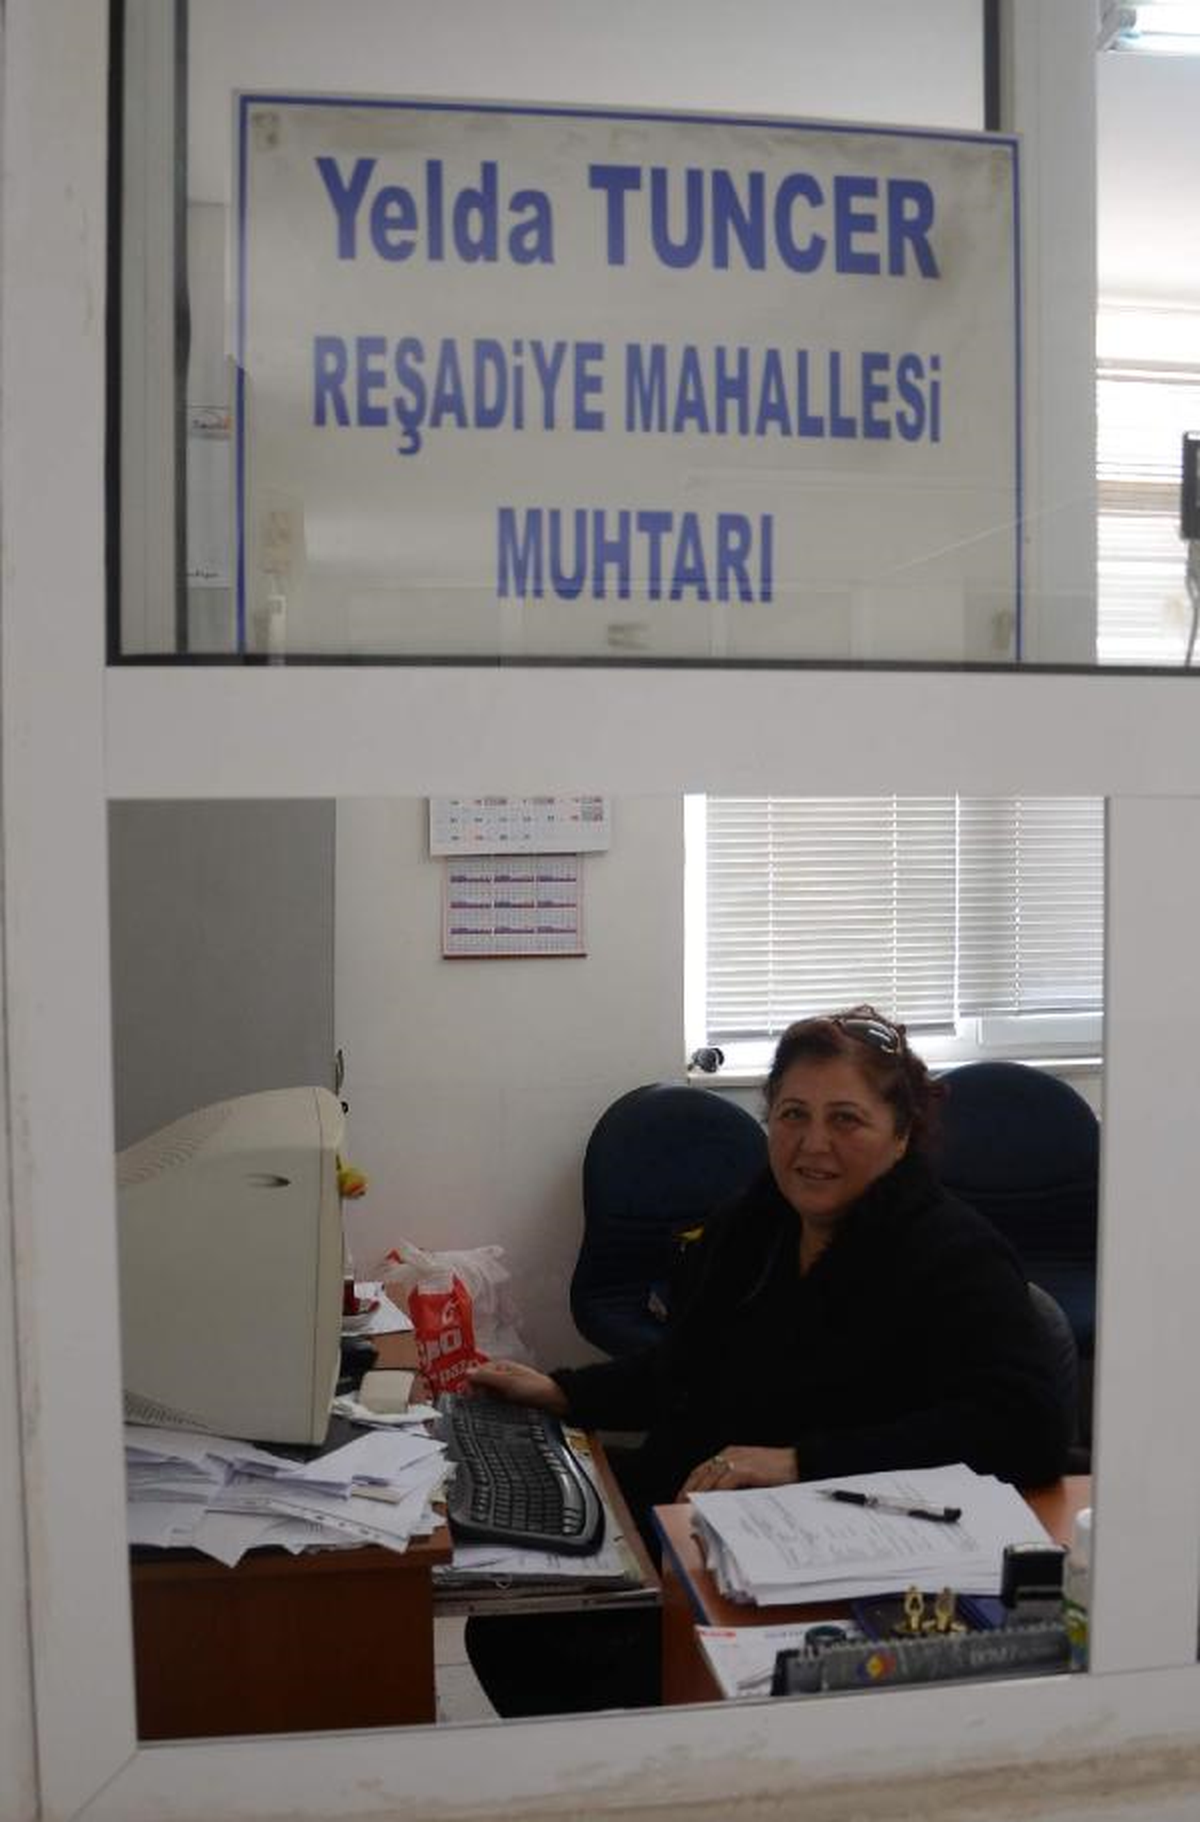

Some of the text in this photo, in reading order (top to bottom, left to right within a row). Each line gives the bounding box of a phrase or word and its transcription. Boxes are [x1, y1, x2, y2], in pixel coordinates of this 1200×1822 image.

[315, 157, 939, 279] Yelda TUNCER
[496, 507, 774, 602] MUHTARI
